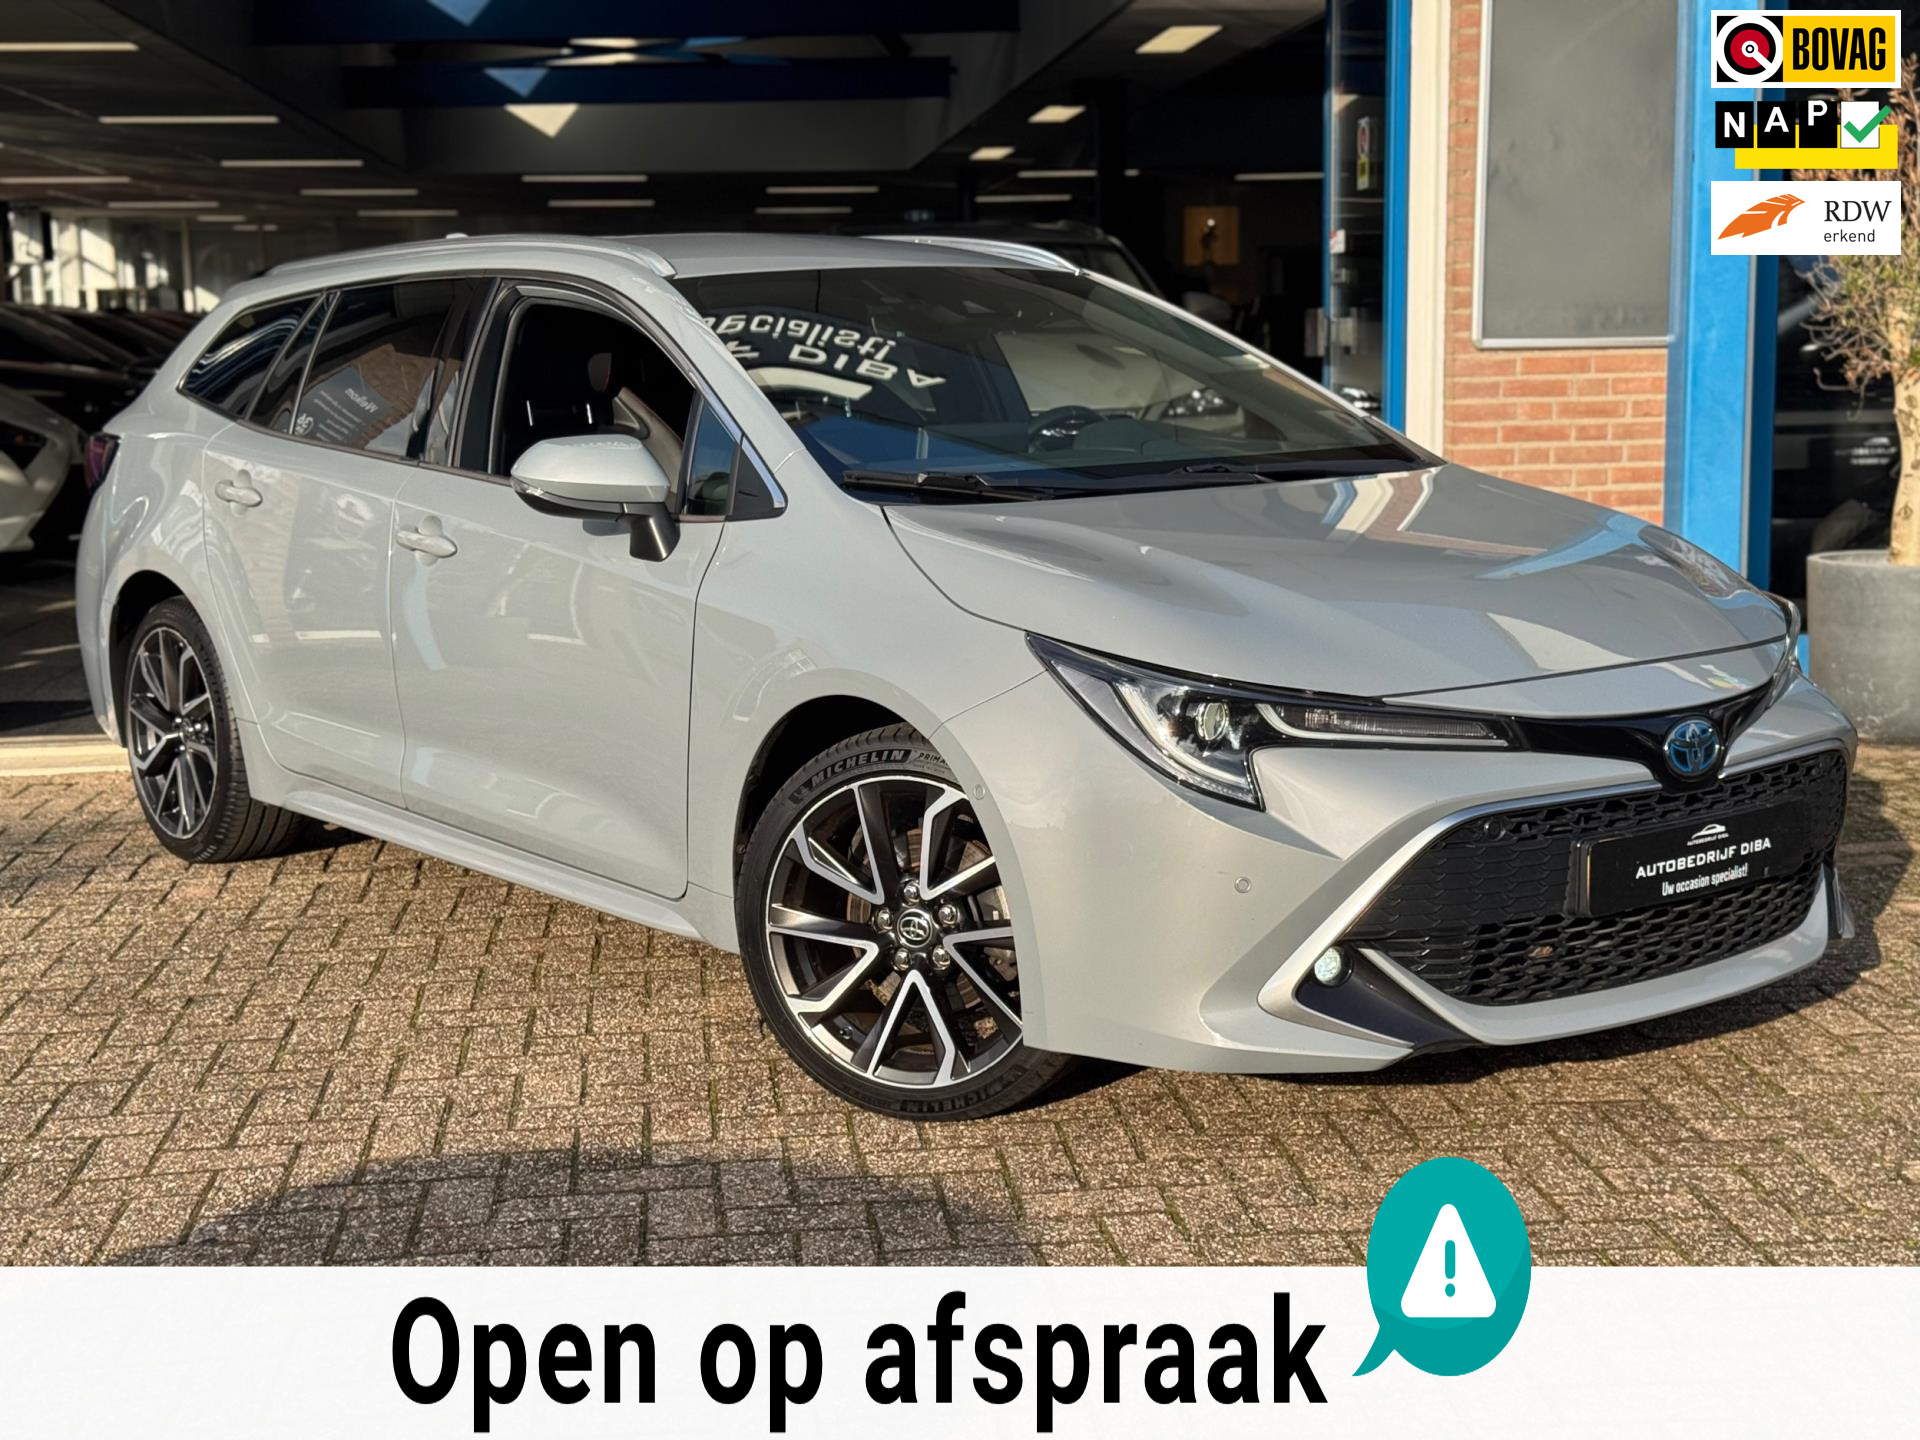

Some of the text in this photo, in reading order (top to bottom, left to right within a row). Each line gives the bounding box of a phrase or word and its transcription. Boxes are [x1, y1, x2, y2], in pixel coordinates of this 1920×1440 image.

[812, 751, 905, 786] MICHELIN
[918, 753, 949, 767] PRIMA
[1635, 837, 1771, 879] AUTOBEDRIJF DIBA
[1662, 863, 1748, 896] Uw occasion specialist!
